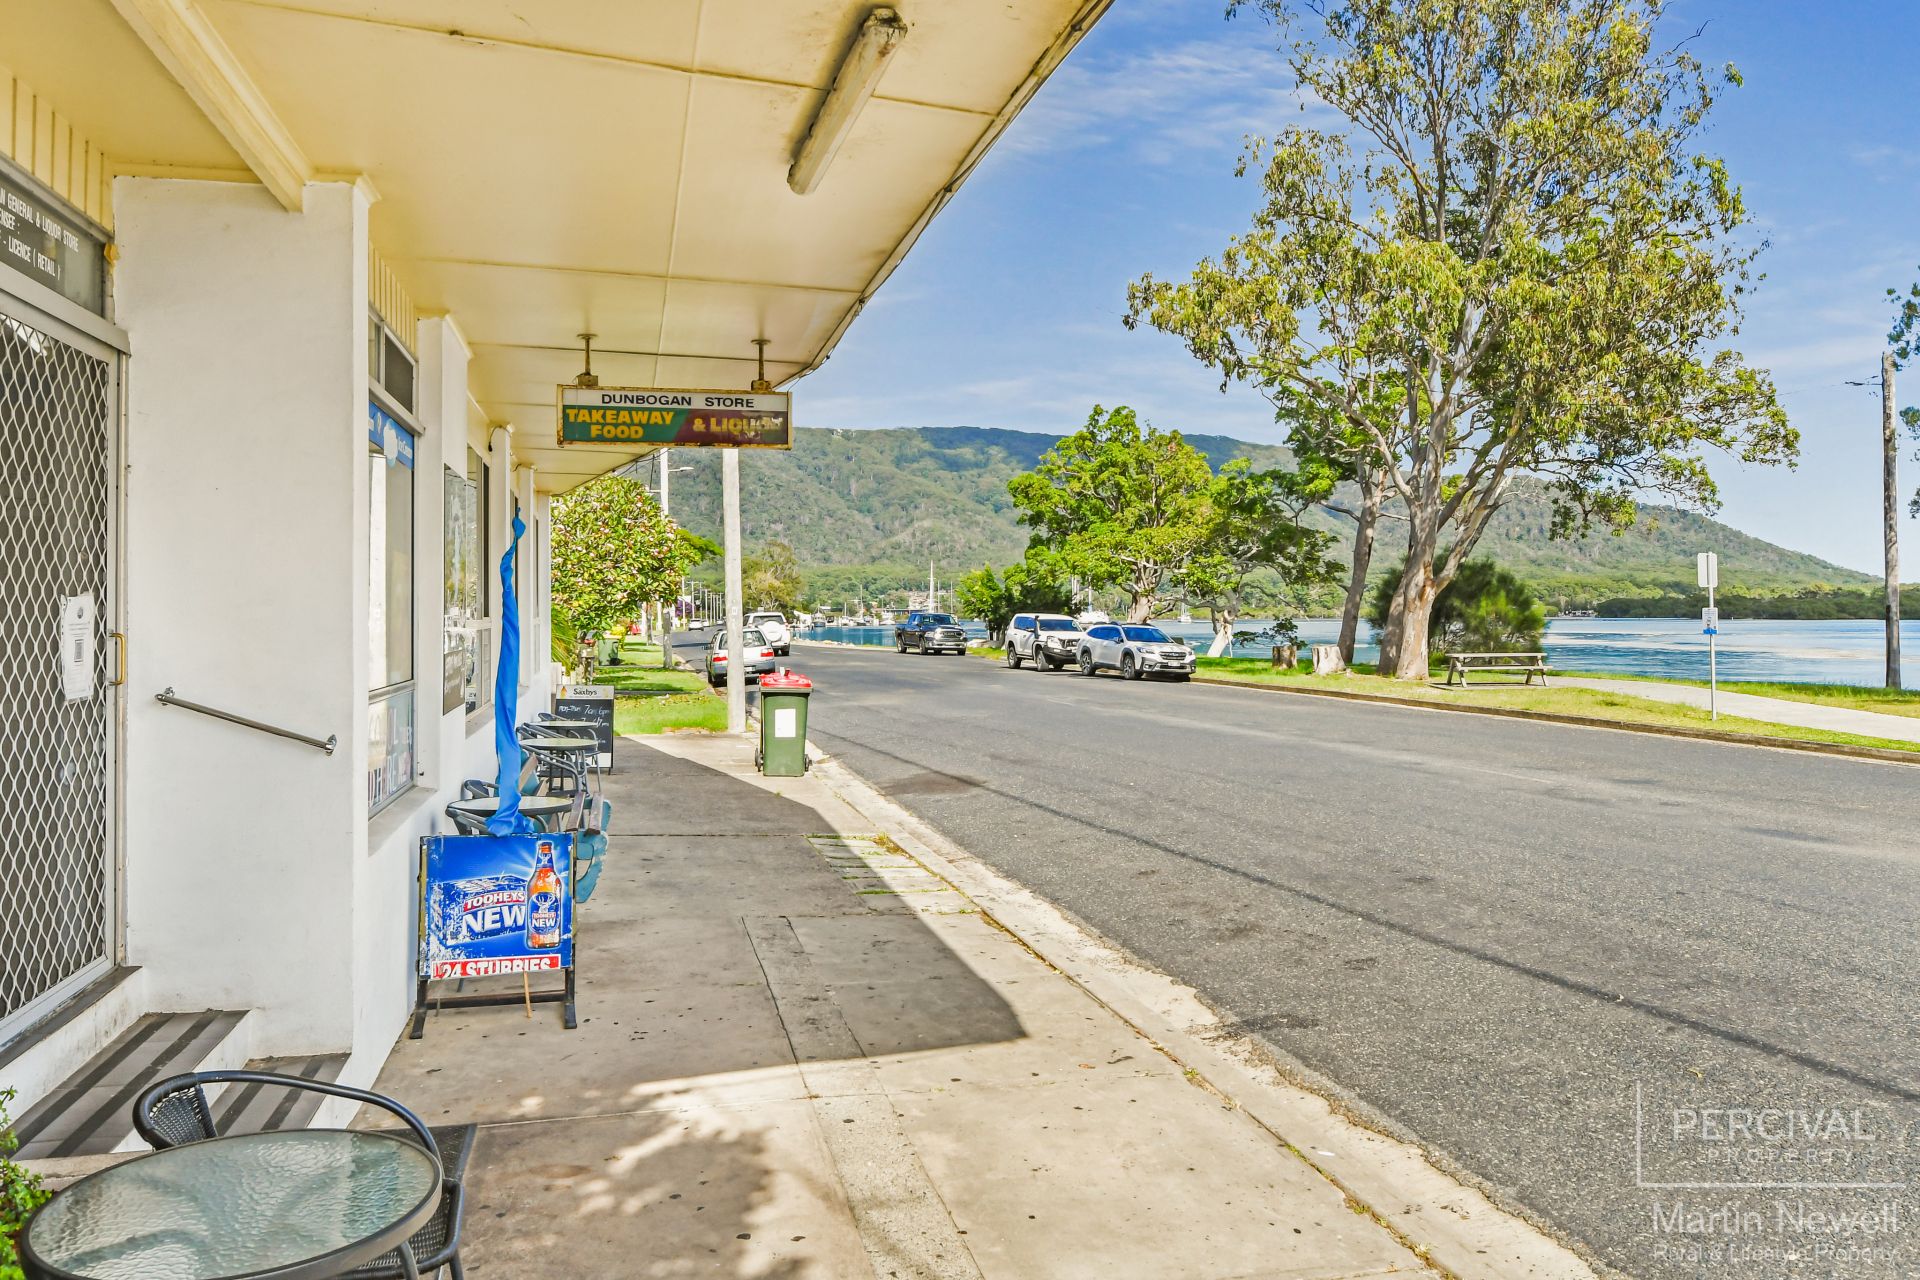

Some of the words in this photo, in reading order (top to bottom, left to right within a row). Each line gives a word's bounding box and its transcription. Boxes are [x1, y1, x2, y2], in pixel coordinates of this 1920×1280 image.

[8, 193, 34, 224] GENERAL
[36, 211, 41, 229] &
[42, 215, 62, 242] LIQUOR
[63, 229, 79, 253] STORE
[8, 235, 31, 263] LICENCE
[37, 252, 56, 277] RETAIL
[601, 394, 692, 406] DUNBOGAN
[705, 397, 754, 408] STORE
[565, 409, 675, 425] TAKEAWAY
[692, 417, 706, 432] &
[590, 425, 644, 439] FOOD
[573, 688, 597, 696] Saxbys
[465, 891, 525, 909] TOOHEYS
[462, 906, 526, 933] NEW
[532, 918, 555, 928] NEW
